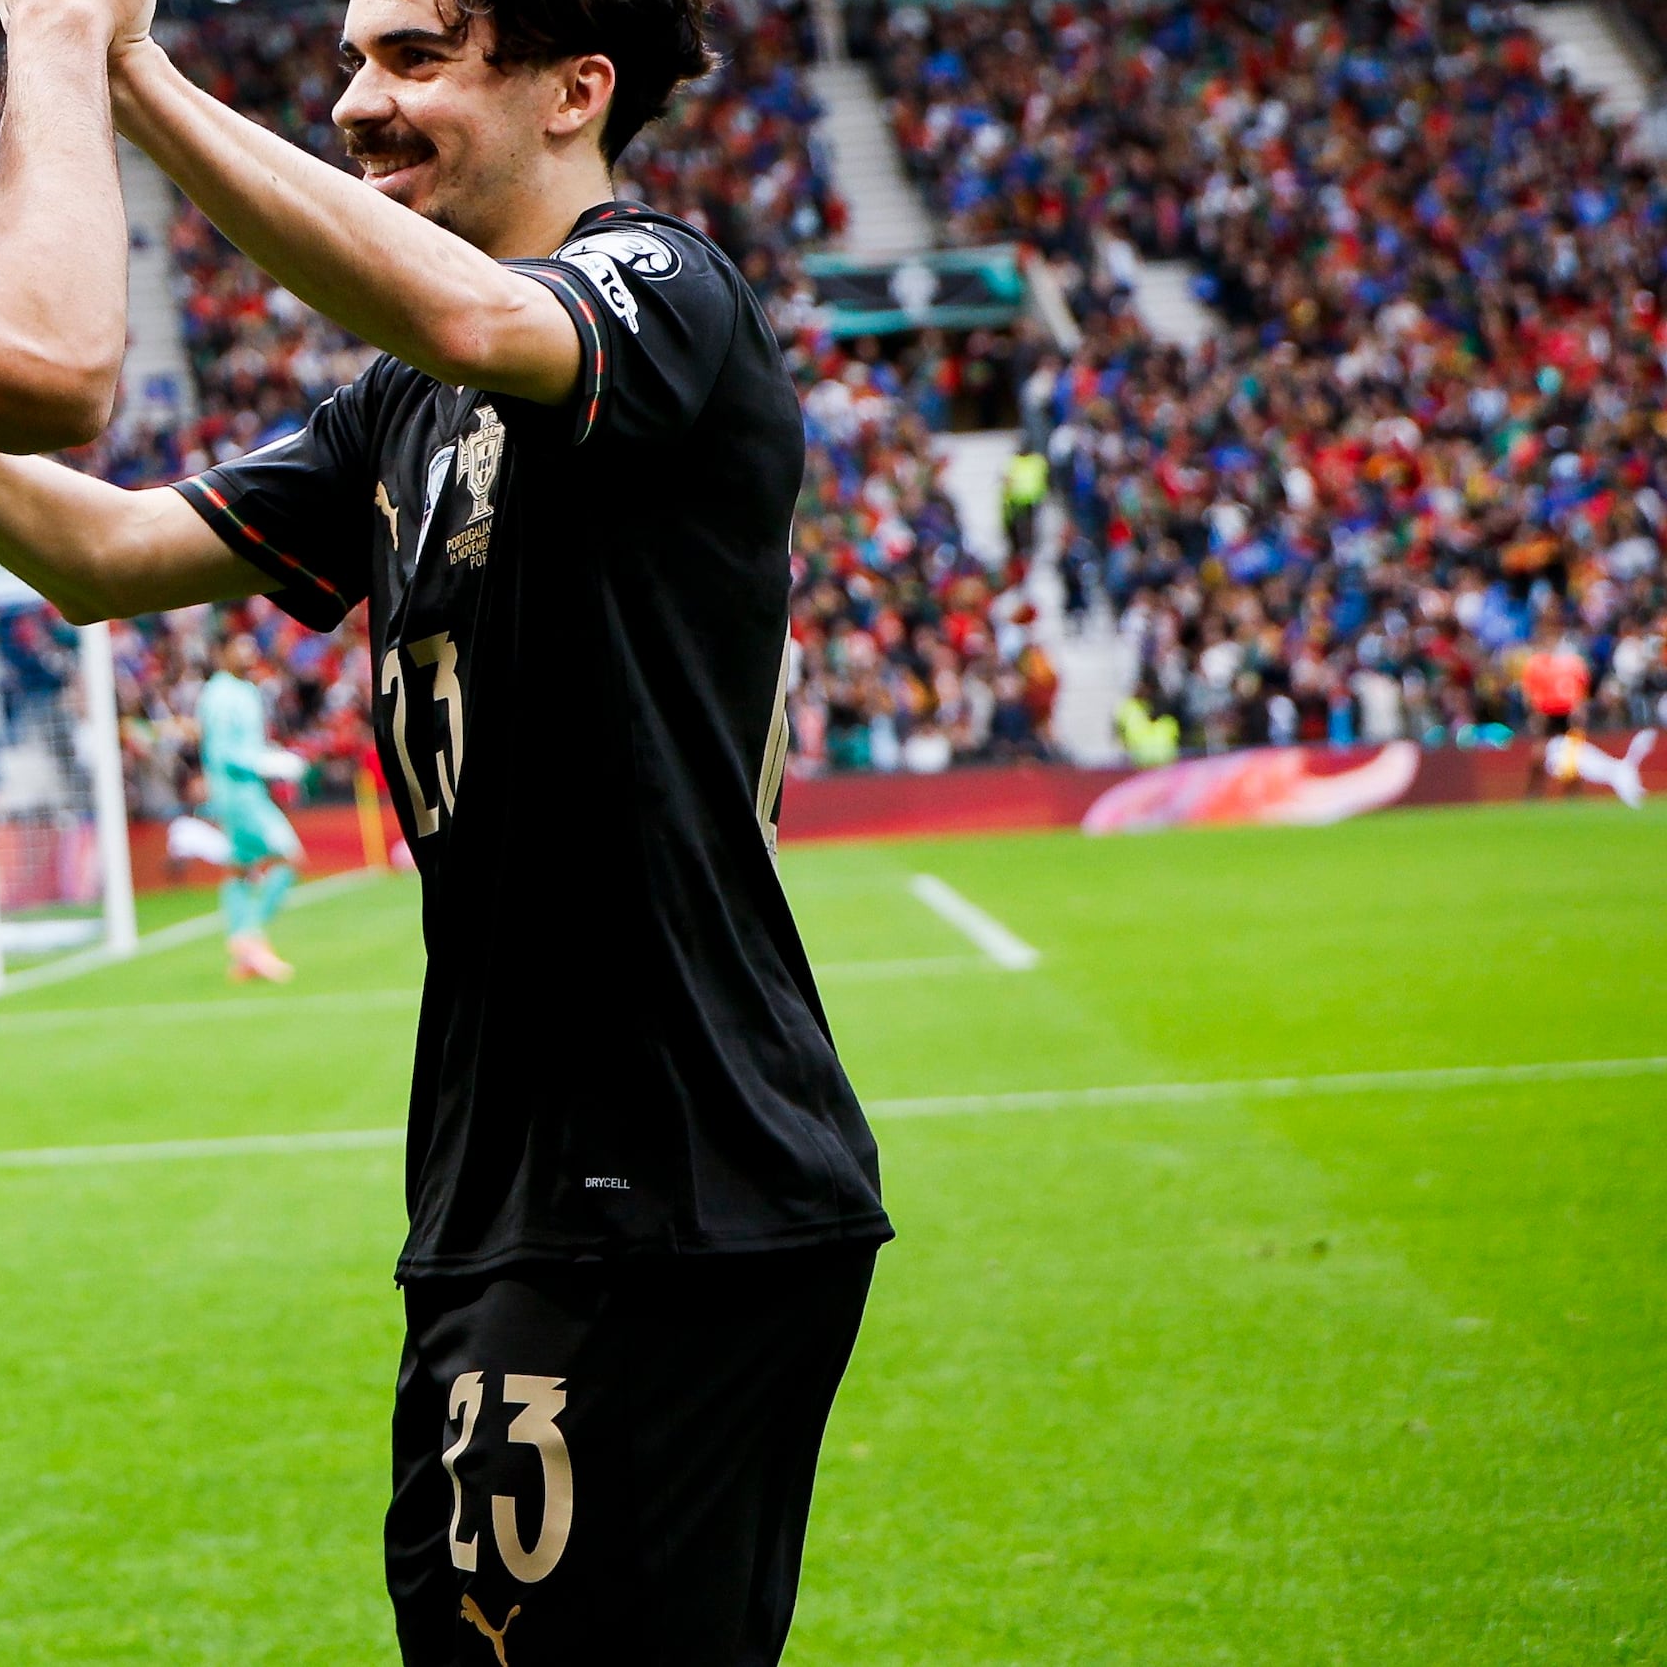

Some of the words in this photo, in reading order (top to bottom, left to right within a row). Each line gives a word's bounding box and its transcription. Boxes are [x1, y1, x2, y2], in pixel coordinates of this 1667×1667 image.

[381, 631, 464, 837] 23
[585, 1177, 631, 1190] DRYCELL
[441, 1370, 574, 1583] 23
